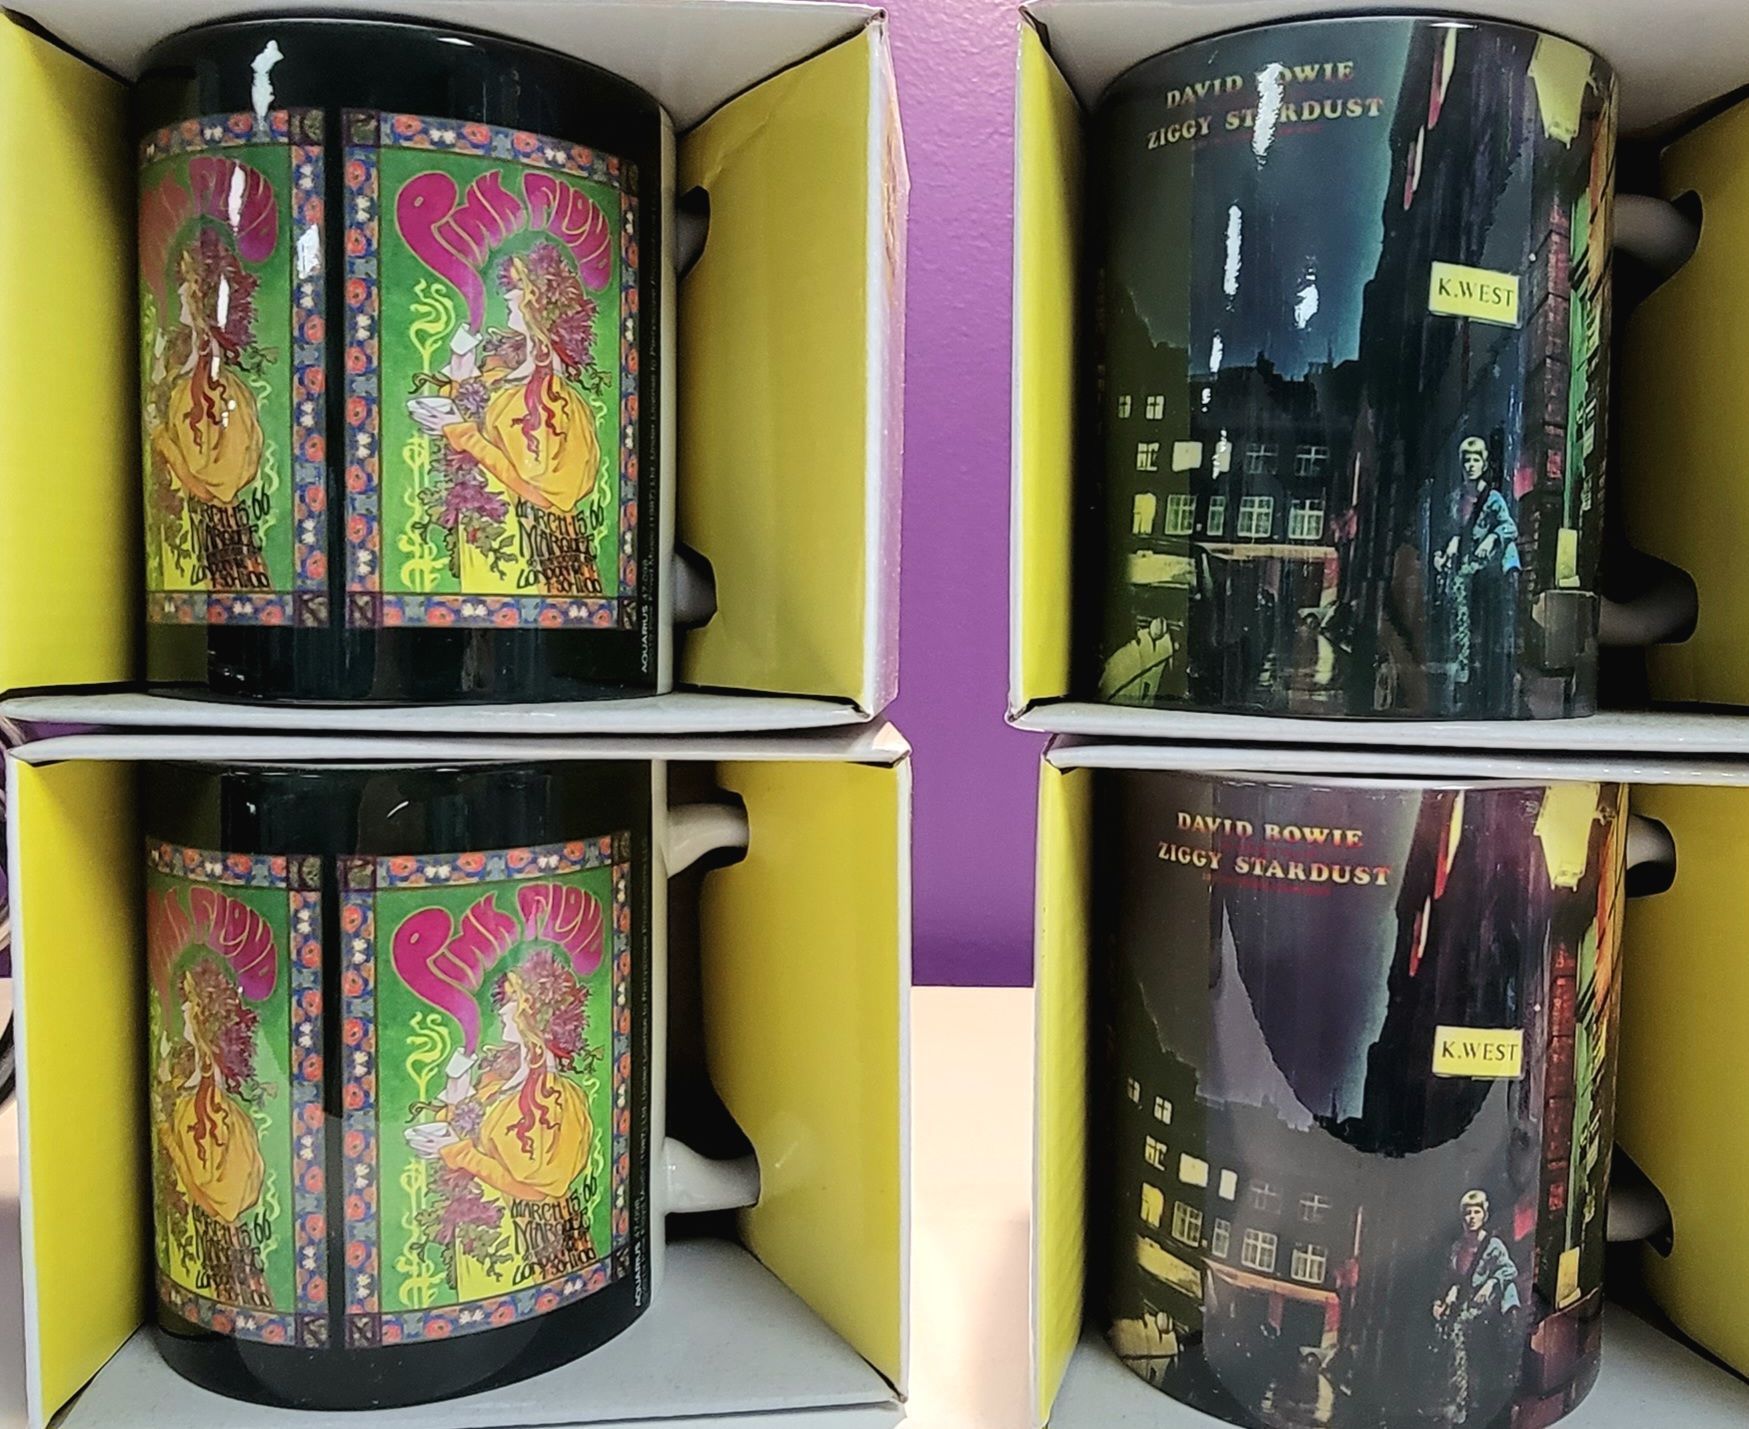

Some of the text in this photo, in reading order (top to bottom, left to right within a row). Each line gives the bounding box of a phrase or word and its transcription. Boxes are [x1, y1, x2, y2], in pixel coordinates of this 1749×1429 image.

[1166, 61, 1355, 109] DAVID OWIE
[1147, 116, 1213, 150] ZIGGY
[1225, 97, 1384, 131] STRDUST
[1438, 277, 1514, 307] K.WEST
[640, 605, 649, 674] AQUARIUS
[1177, 811, 1364, 848] DAVID BOWIE
[1157, 841, 1222, 870] ZIGGY
[1234, 855, 1392, 886] STARDUST
[1441, 1041, 1519, 1062] K.WEST
